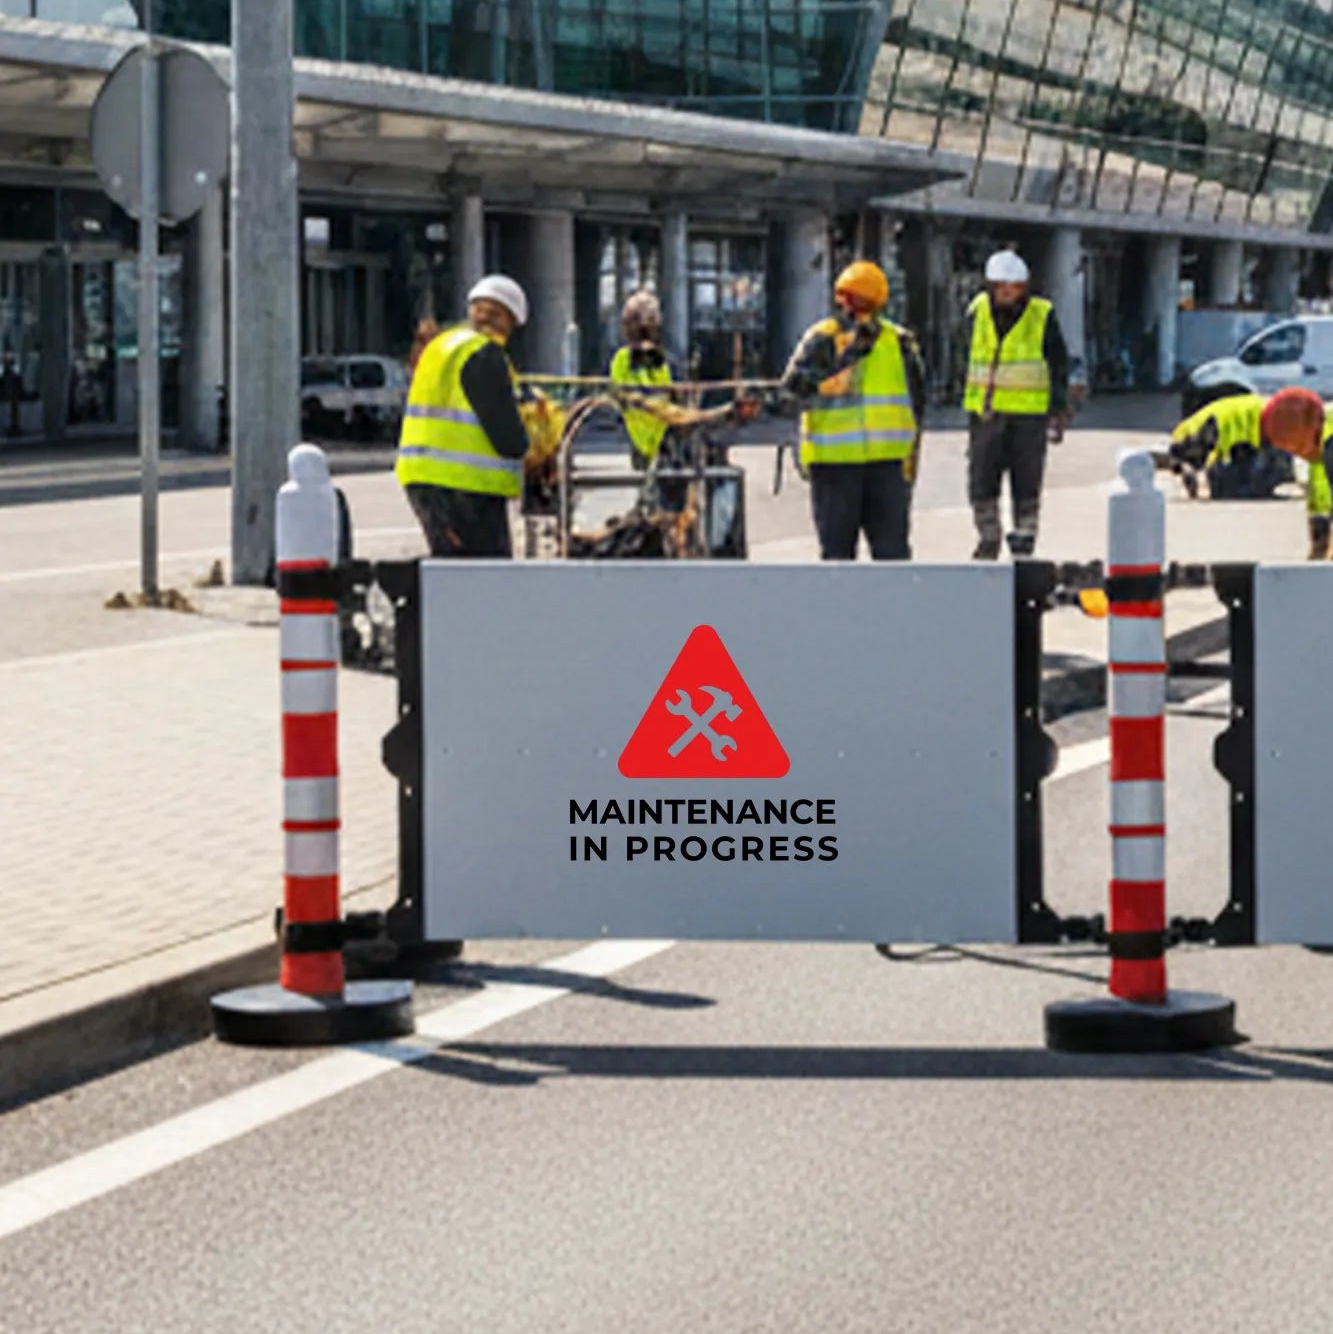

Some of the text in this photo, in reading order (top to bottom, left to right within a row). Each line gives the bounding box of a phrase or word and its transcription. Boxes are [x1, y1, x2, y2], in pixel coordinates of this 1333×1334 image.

[569, 798, 837, 825] MAINTENANCE
[569, 835, 839, 862] IN PROGRESS
